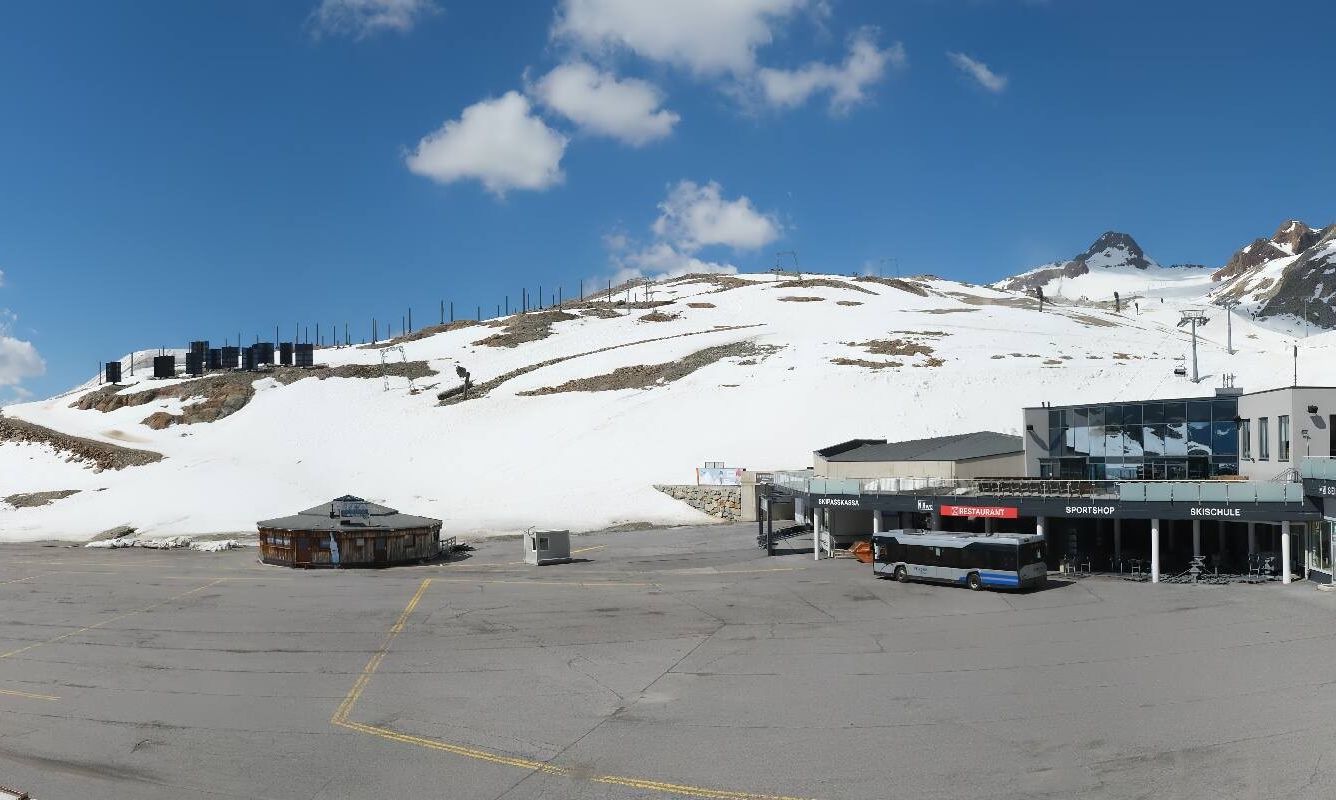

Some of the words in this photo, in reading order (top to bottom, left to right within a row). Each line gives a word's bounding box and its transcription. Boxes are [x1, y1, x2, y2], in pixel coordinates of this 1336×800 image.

[959, 507, 1005, 516] RESTAURANT
[1065, 506, 1115, 515] SPORTSHOP
[1190, 507, 1241, 517] SKISCHULE
